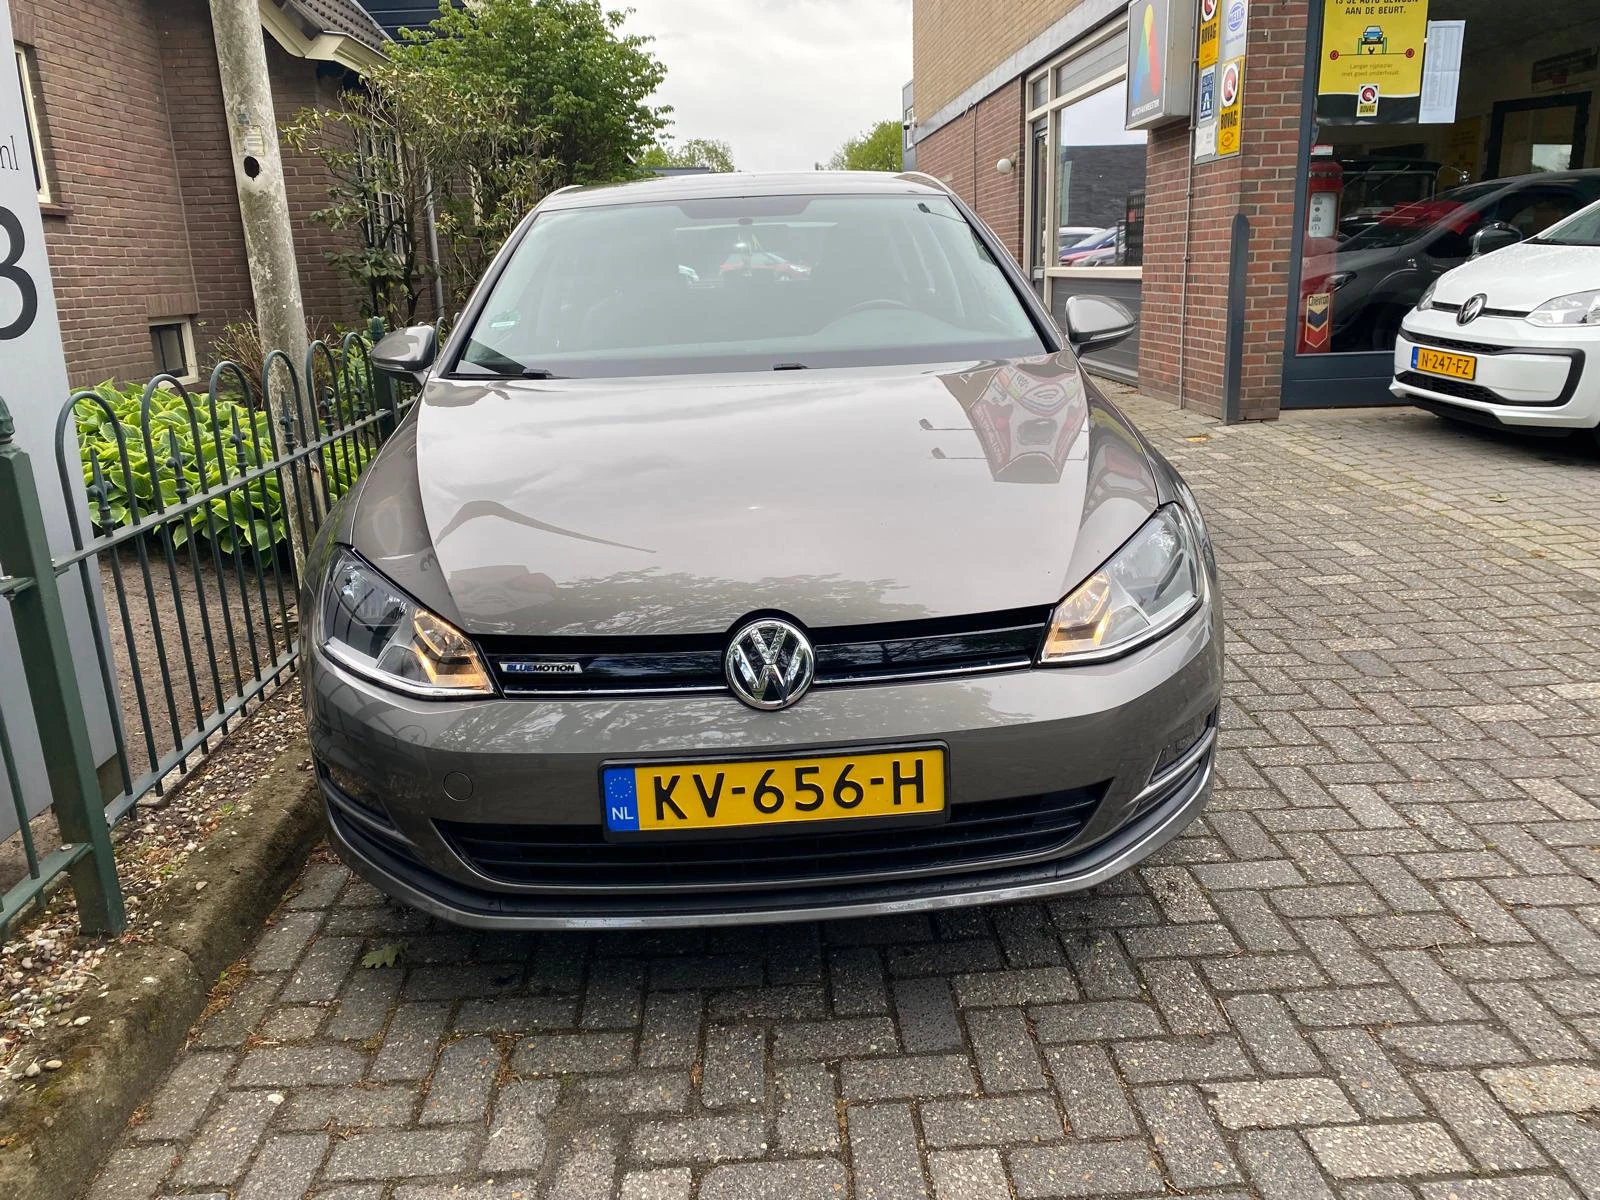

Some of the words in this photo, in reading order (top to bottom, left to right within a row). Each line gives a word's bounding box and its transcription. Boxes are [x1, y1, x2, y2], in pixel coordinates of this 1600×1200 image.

[1345, 7, 1362, 15] AAN
[1365, 6, 1375, 15] DE
[1378, 6, 1407, 14] BEURT.
[1220, 111, 1238, 130] BOVAG
[1421, 352, 1471, 375] N-247-FZ
[506, 664, 575, 672] BLUEMOTION
[653, 759, 924, 821] KV-656-H
[611, 807, 634, 821] NL
